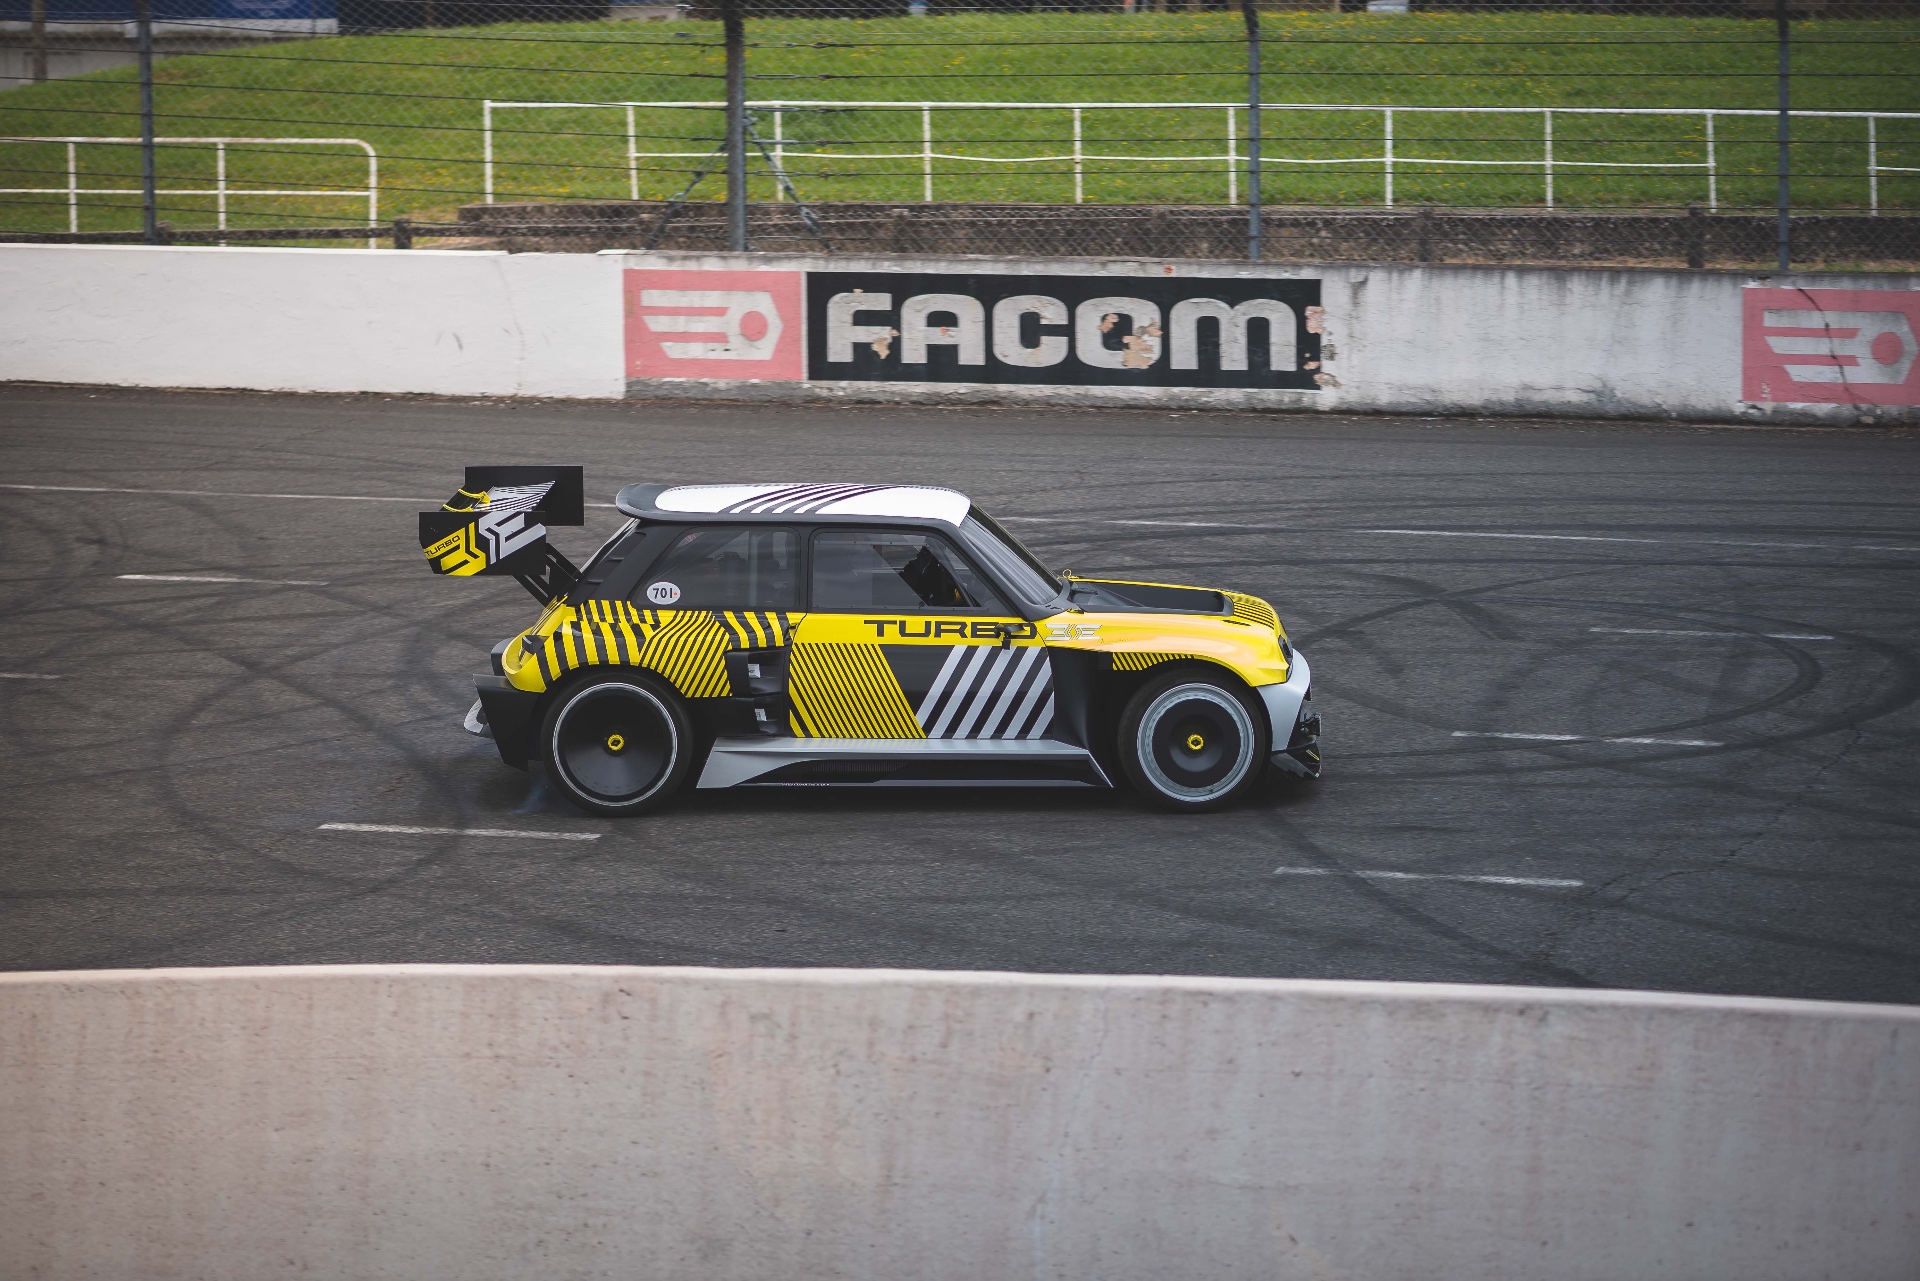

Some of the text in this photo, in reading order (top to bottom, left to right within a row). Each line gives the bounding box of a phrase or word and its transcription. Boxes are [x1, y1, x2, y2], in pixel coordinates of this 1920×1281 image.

[827, 292, 1297, 372] FACOM
[425, 534, 461, 557] TURBO
[653, 588, 673, 599] 701
